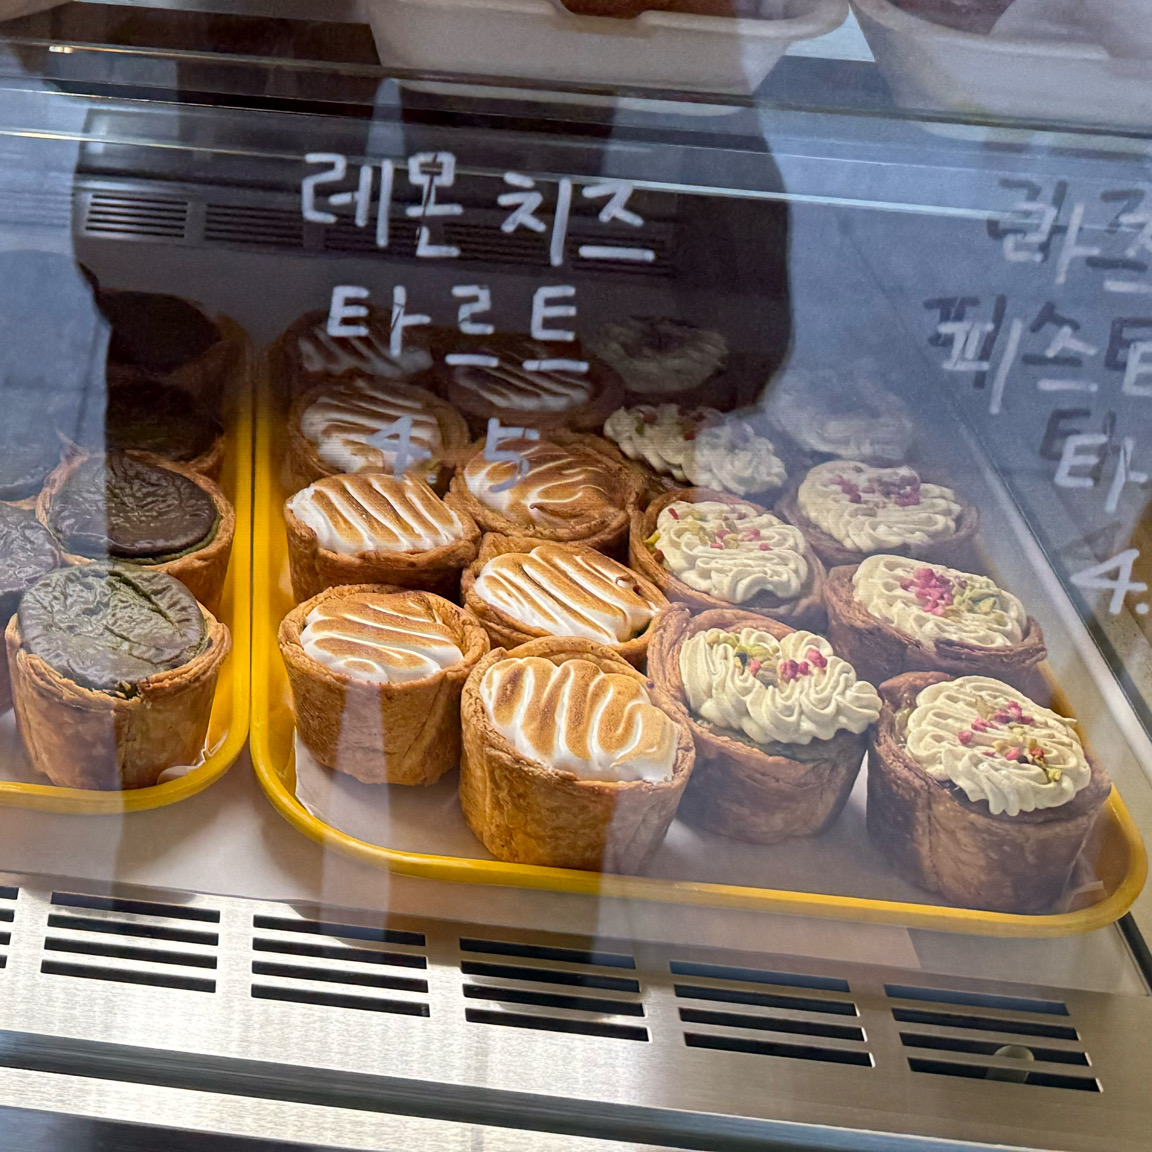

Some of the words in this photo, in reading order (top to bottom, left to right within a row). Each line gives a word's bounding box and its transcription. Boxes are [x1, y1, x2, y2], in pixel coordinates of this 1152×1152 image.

[301, 151, 464, 258] 레몬
[497, 171, 656, 267] 치즈
[326, 285, 590, 373] 타르트
